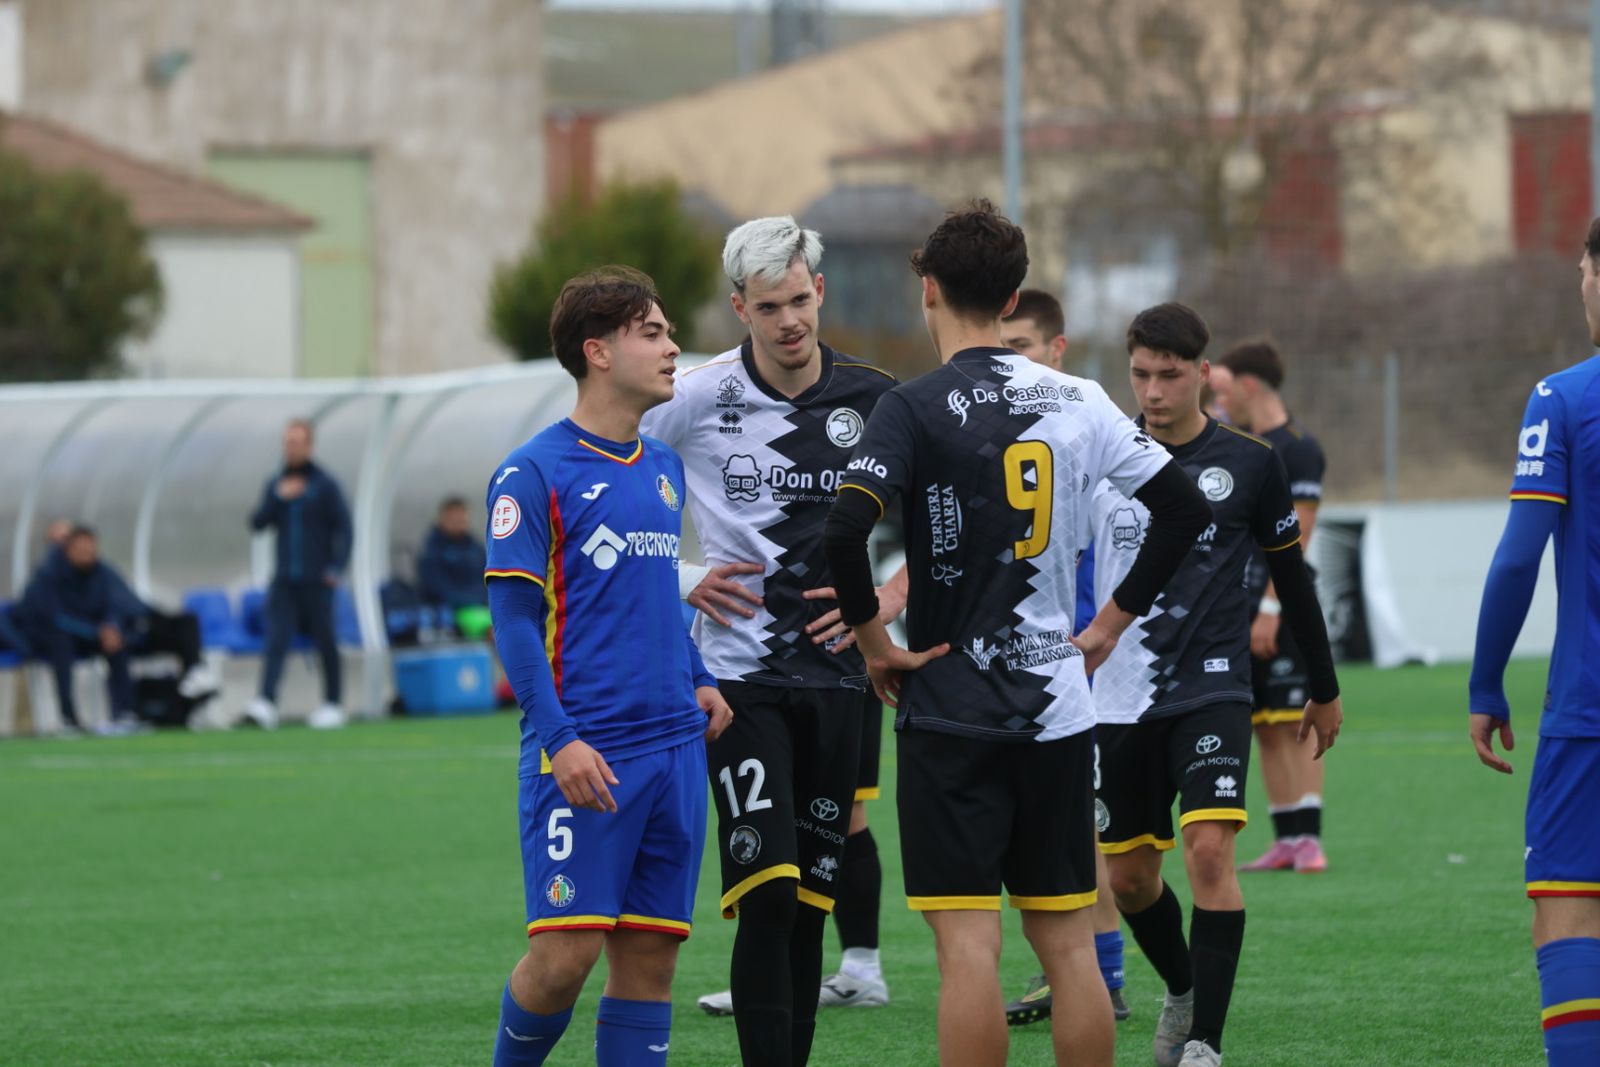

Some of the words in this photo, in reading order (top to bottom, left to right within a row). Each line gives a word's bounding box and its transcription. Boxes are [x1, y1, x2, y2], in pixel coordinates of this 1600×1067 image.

[972, 387, 999, 404] De
[1002, 383, 1059, 403] Castro
[1060, 385, 1084, 402] Gil
[1008, 402, 1062, 415] ABOGADOS
[770, 466, 813, 489] Don
[1002, 439, 1054, 561] 9
[926, 482, 944, 557] TERNERA
[942, 484, 959, 551] CHARRA
[625, 531, 680, 559] TECNOC
[1005, 633, 1040, 656] CAJA
[1038, 629, 1070, 649] RUR
[1006, 658, 1020, 671] DE
[1207, 756, 1240, 767] MOTOR
[718, 757, 773, 819] 12
[1215, 789, 1237, 798] errea
[547, 807, 574, 861] 5
[814, 826, 846, 846] MOTOR
